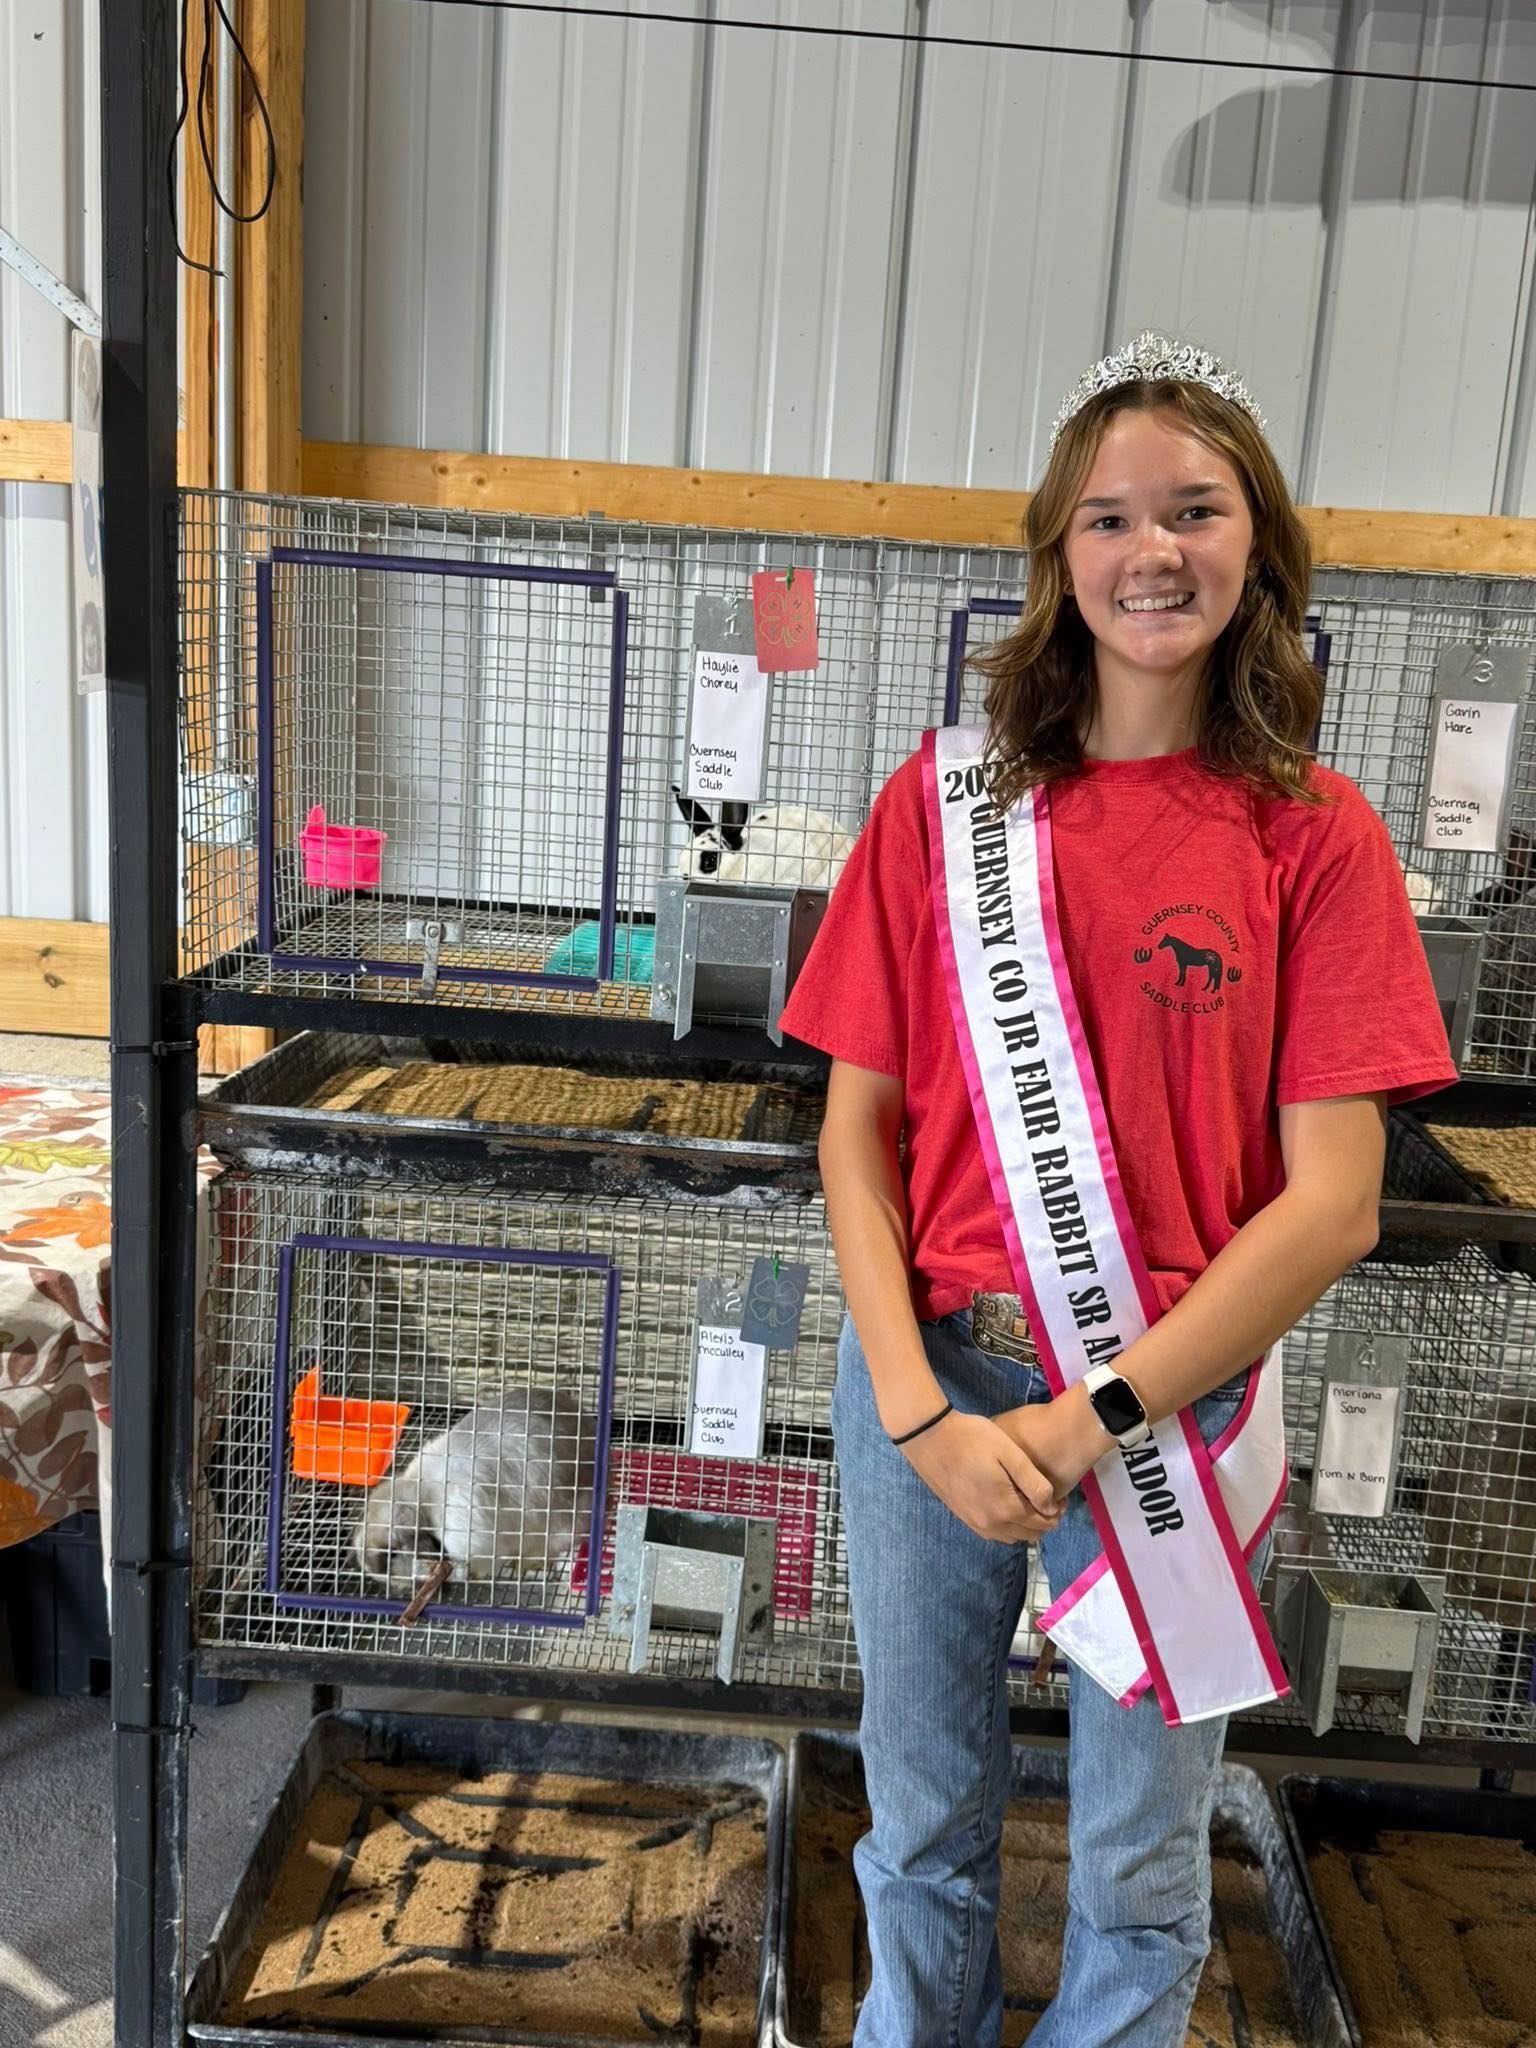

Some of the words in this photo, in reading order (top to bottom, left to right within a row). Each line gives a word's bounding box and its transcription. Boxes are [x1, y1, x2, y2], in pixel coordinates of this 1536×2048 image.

[724, 612, 741, 637] 1
[702, 656, 740, 677] Haylie
[1472, 660, 1494, 683] 3
[700, 676, 738, 693] Chorey
[1445, 703, 1480, 719] Gavin
[1445, 721, 1472, 735] Hare
[695, 761, 733, 777] Saddle
[698, 777, 723, 790] Club
[1428, 795, 1480, 814] Guernsey
[1434, 812, 1473, 825] Saddle
[970, 801, 1017, 950] GUERNSEY
[1141, 904, 1203, 935] GUERNSEY
[1206, 909, 1240, 954] COUNTY
[988, 959, 1028, 1003] CO
[1140, 981, 1189, 1013] SADDLE
[1192, 996, 1225, 1014] CLUB
[993, 1009, 1041, 1054] JR
[1011, 1058, 1061, 1140] FAIR
[1031, 1144, 1098, 1276] RABBIT
[725, 1290, 743, 1312] 2
[1067, 1285, 1112, 1330] SR
[702, 1417, 736, 1431] Saddle
[700, 1432, 725, 1444] Club
[1319, 1468, 1343, 1479] Turn
[1347, 1471, 1355, 1481] N
[1360, 1471, 1385, 1485] Burn
